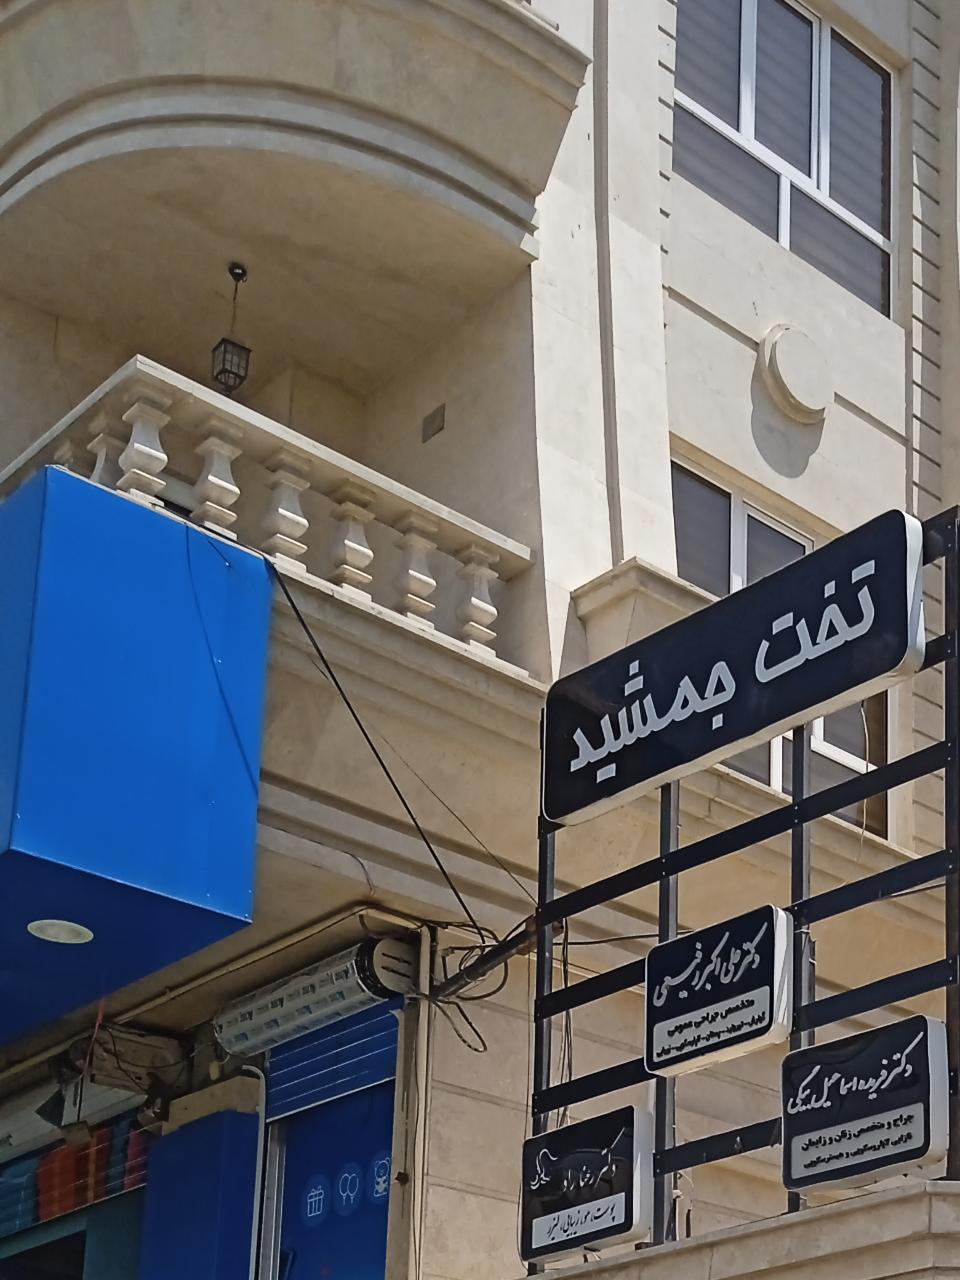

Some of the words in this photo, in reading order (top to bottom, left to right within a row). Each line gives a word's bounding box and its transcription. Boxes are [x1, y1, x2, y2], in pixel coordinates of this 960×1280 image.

[754, 559, 876, 684] تخت
[569, 660, 737, 784] جمشید
[653, 941, 703, 1007] رفیعی
[694, 931, 730, 991] اکبر
[719, 947, 742, 984] علی
[733, 921, 769, 983] دکتر
[858, 1058, 888, 1100] فریده
[880, 1031, 924, 1089] دکتر
[593, 1126, 626, 1189] دکتر
